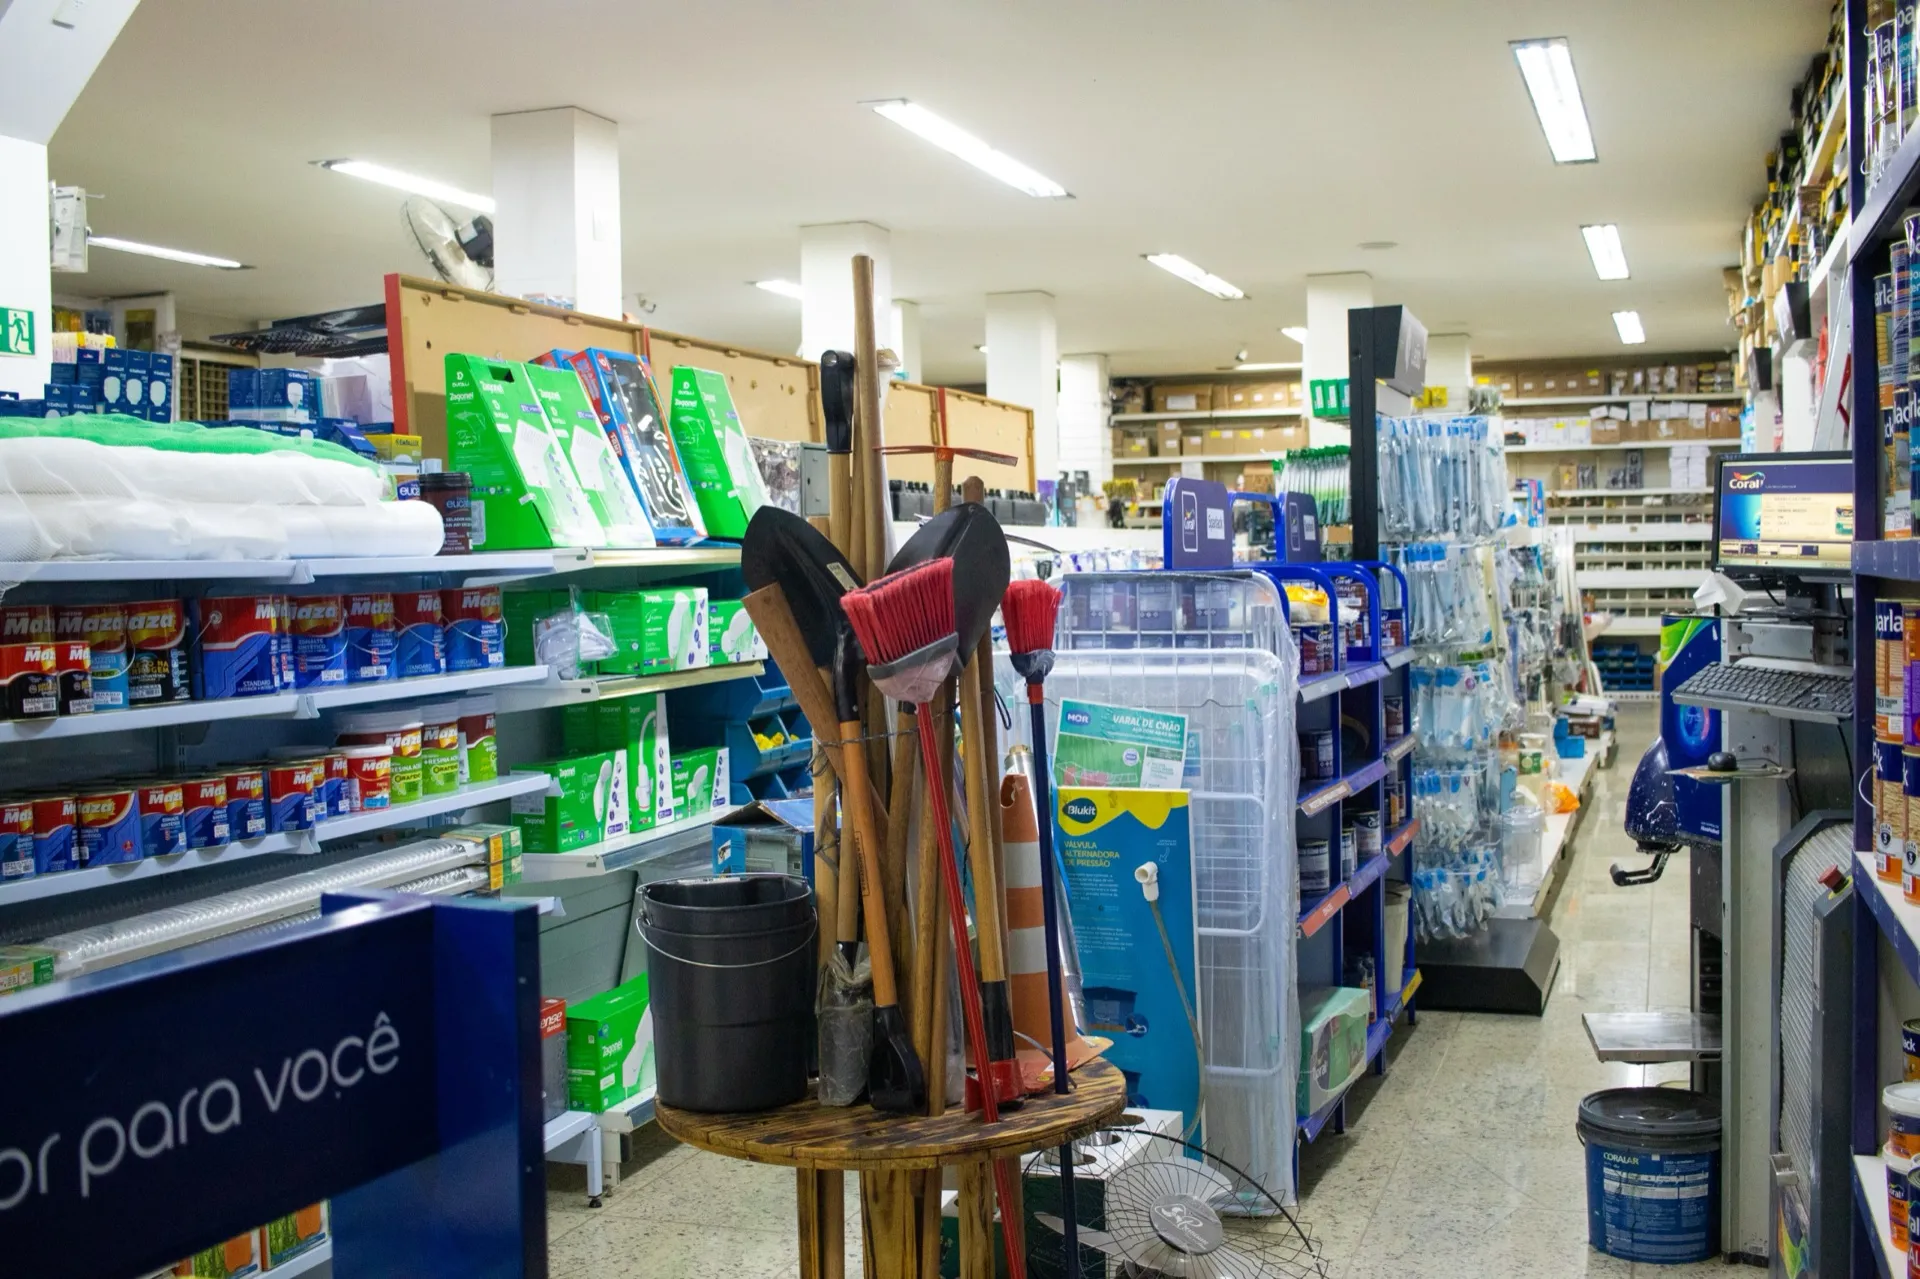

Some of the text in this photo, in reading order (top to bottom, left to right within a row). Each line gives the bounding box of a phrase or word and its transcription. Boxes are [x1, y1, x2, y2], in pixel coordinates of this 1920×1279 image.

[449, 392, 474, 402] Zagonel
[674, 398, 697, 408] Zagonel
[1729, 478, 1760, 489] Coral
[351, 601, 394, 615] Maz
[462, 595, 500, 609] Maz
[4, 616, 55, 636] Maz
[128, 614, 175, 631] aza
[25, 649, 56, 662] Maz
[1067, 713, 1089, 724] MOR
[1113, 714, 1140, 726] VARAL
[1142, 717, 1153, 729] DE
[362, 760, 390, 772] Maz
[1067, 805, 1096, 816] Blukit
[1064, 850, 1120, 859] ALTERNADORA
[1076, 858, 1111, 868] PRESSÃO
[602, 1038, 623, 1058] Zagonel
[80, 1078, 242, 1198] para
[254, 1011, 400, 1113] você
[1603, 1151, 1639, 1166] CORALAR
